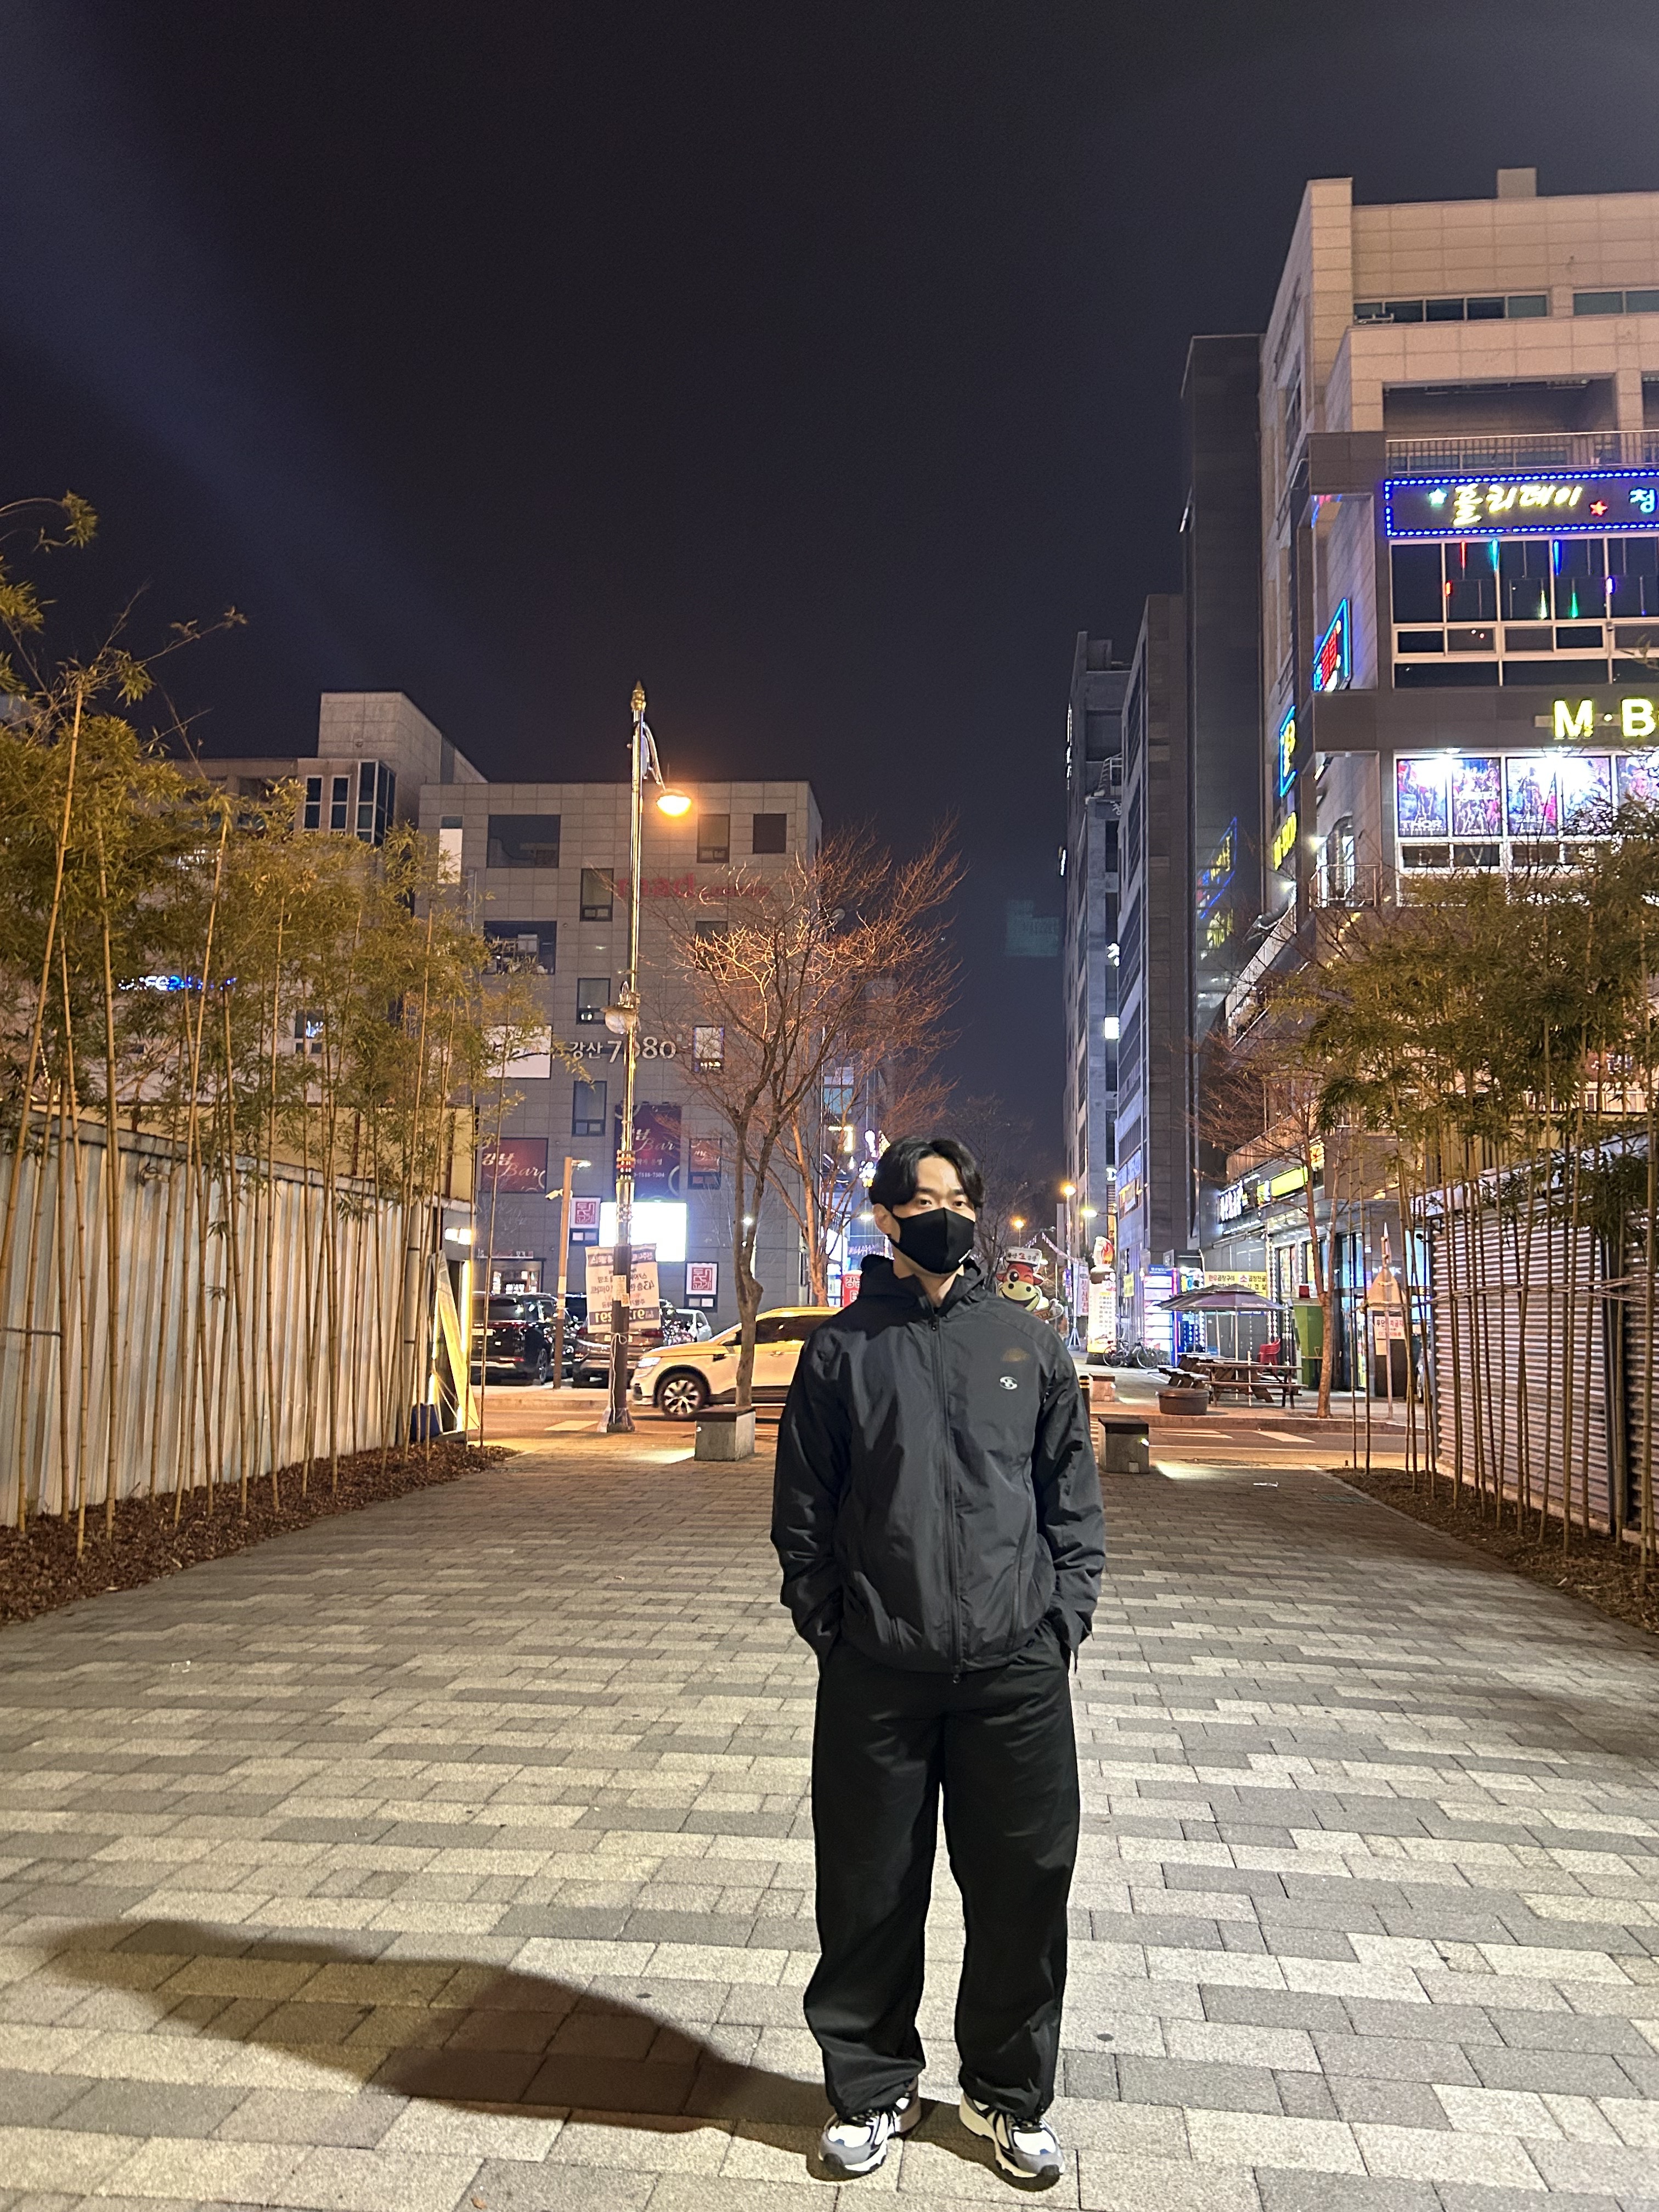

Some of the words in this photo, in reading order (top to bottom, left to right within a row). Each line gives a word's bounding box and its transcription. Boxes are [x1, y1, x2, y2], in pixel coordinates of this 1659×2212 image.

[1453, 483, 1583, 526] 홀리데이
[1554, 698, 1659, 738] M·B
[569, 1041, 603, 1059] 강산
[635, 1137, 676, 1153] Bar
[482, 1153, 515, 1166] 강남
[487, 1163, 541, 1178] Bar
